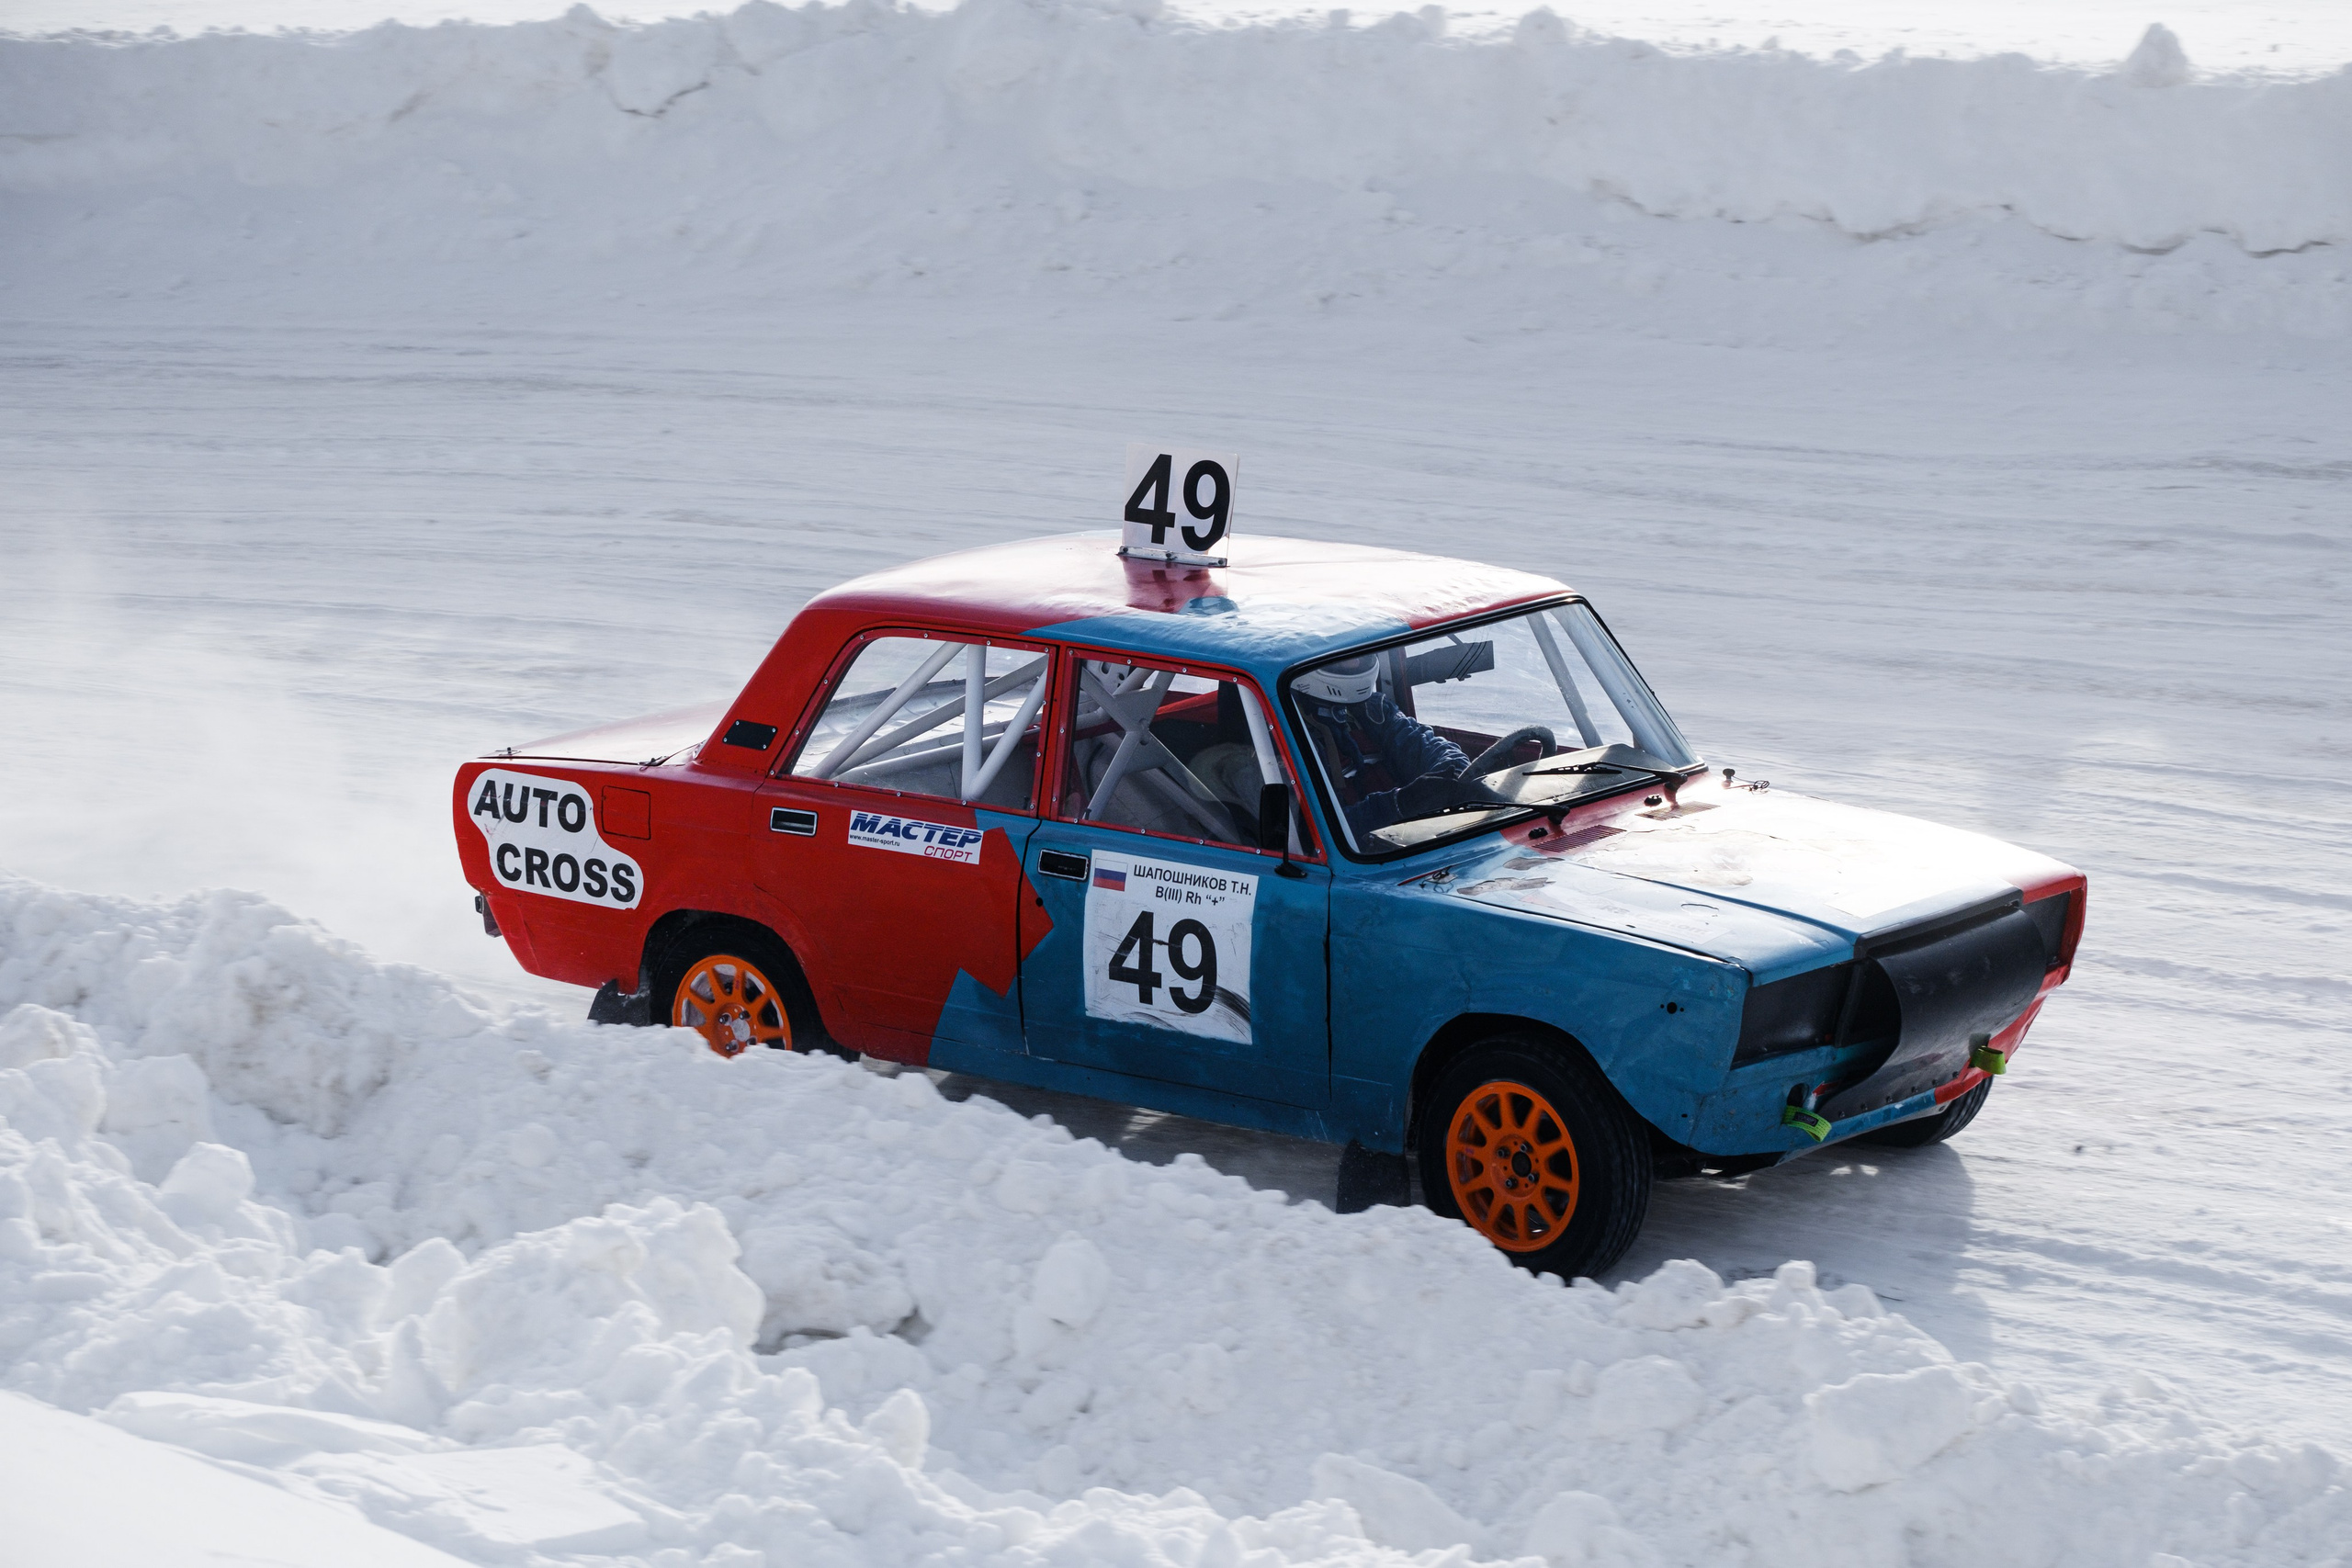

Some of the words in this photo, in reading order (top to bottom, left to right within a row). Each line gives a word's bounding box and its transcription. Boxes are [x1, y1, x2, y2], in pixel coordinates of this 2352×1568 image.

[1125, 454, 1230, 551] 49
[473, 779, 586, 833] AUTO
[849, 834, 900, 846] www.master-sport.ru
[850, 812, 982, 849] МАСТЕР
[924, 845, 973, 862] СПОРТ
[496, 842, 636, 903] CROSS
[1133, 864, 1227, 891] ШАПОШНИКОВ
[1231, 880, 1252, 897] Т.Н.
[1185, 892, 1202, 905] Rh
[1108, 910, 1217, 1014] 49
